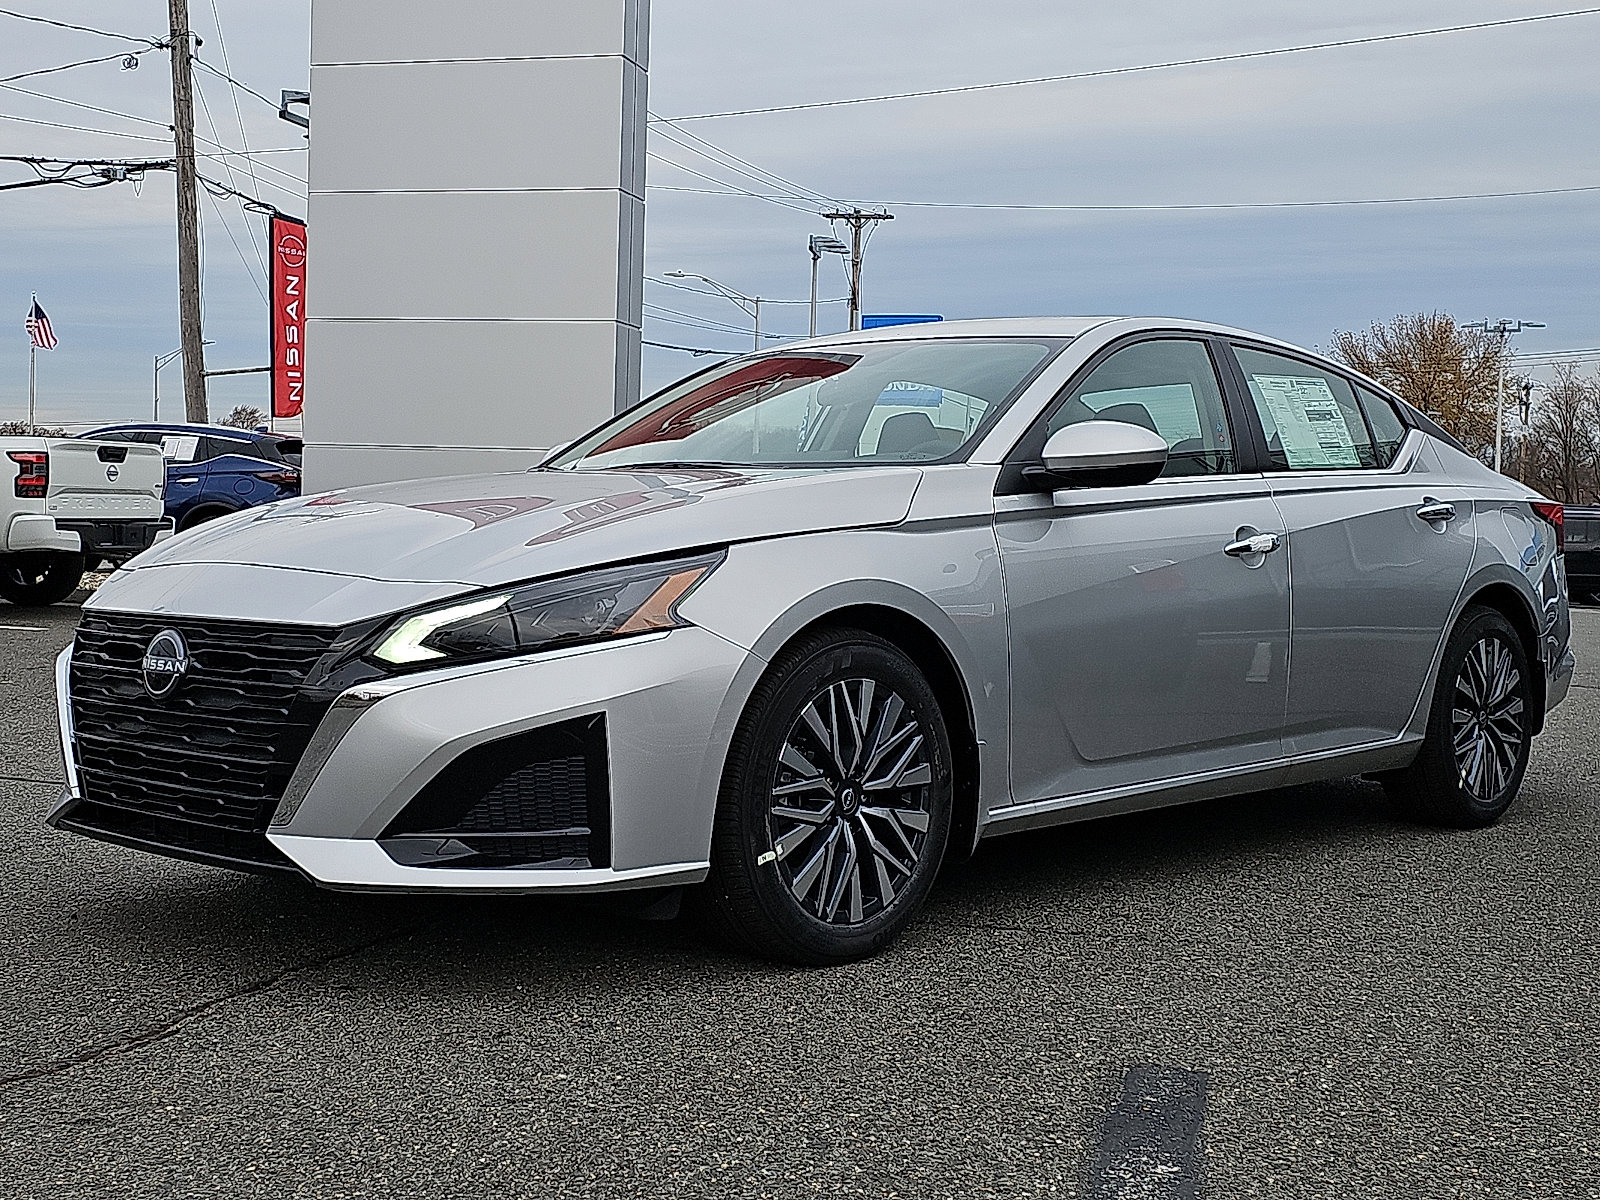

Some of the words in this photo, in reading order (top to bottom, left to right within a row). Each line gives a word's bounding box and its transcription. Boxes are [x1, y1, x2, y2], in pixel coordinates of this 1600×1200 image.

[286, 275, 303, 401] NISSAN
[59, 498, 152, 509] FRONTIER
[143, 657, 186, 673] NISSAN
